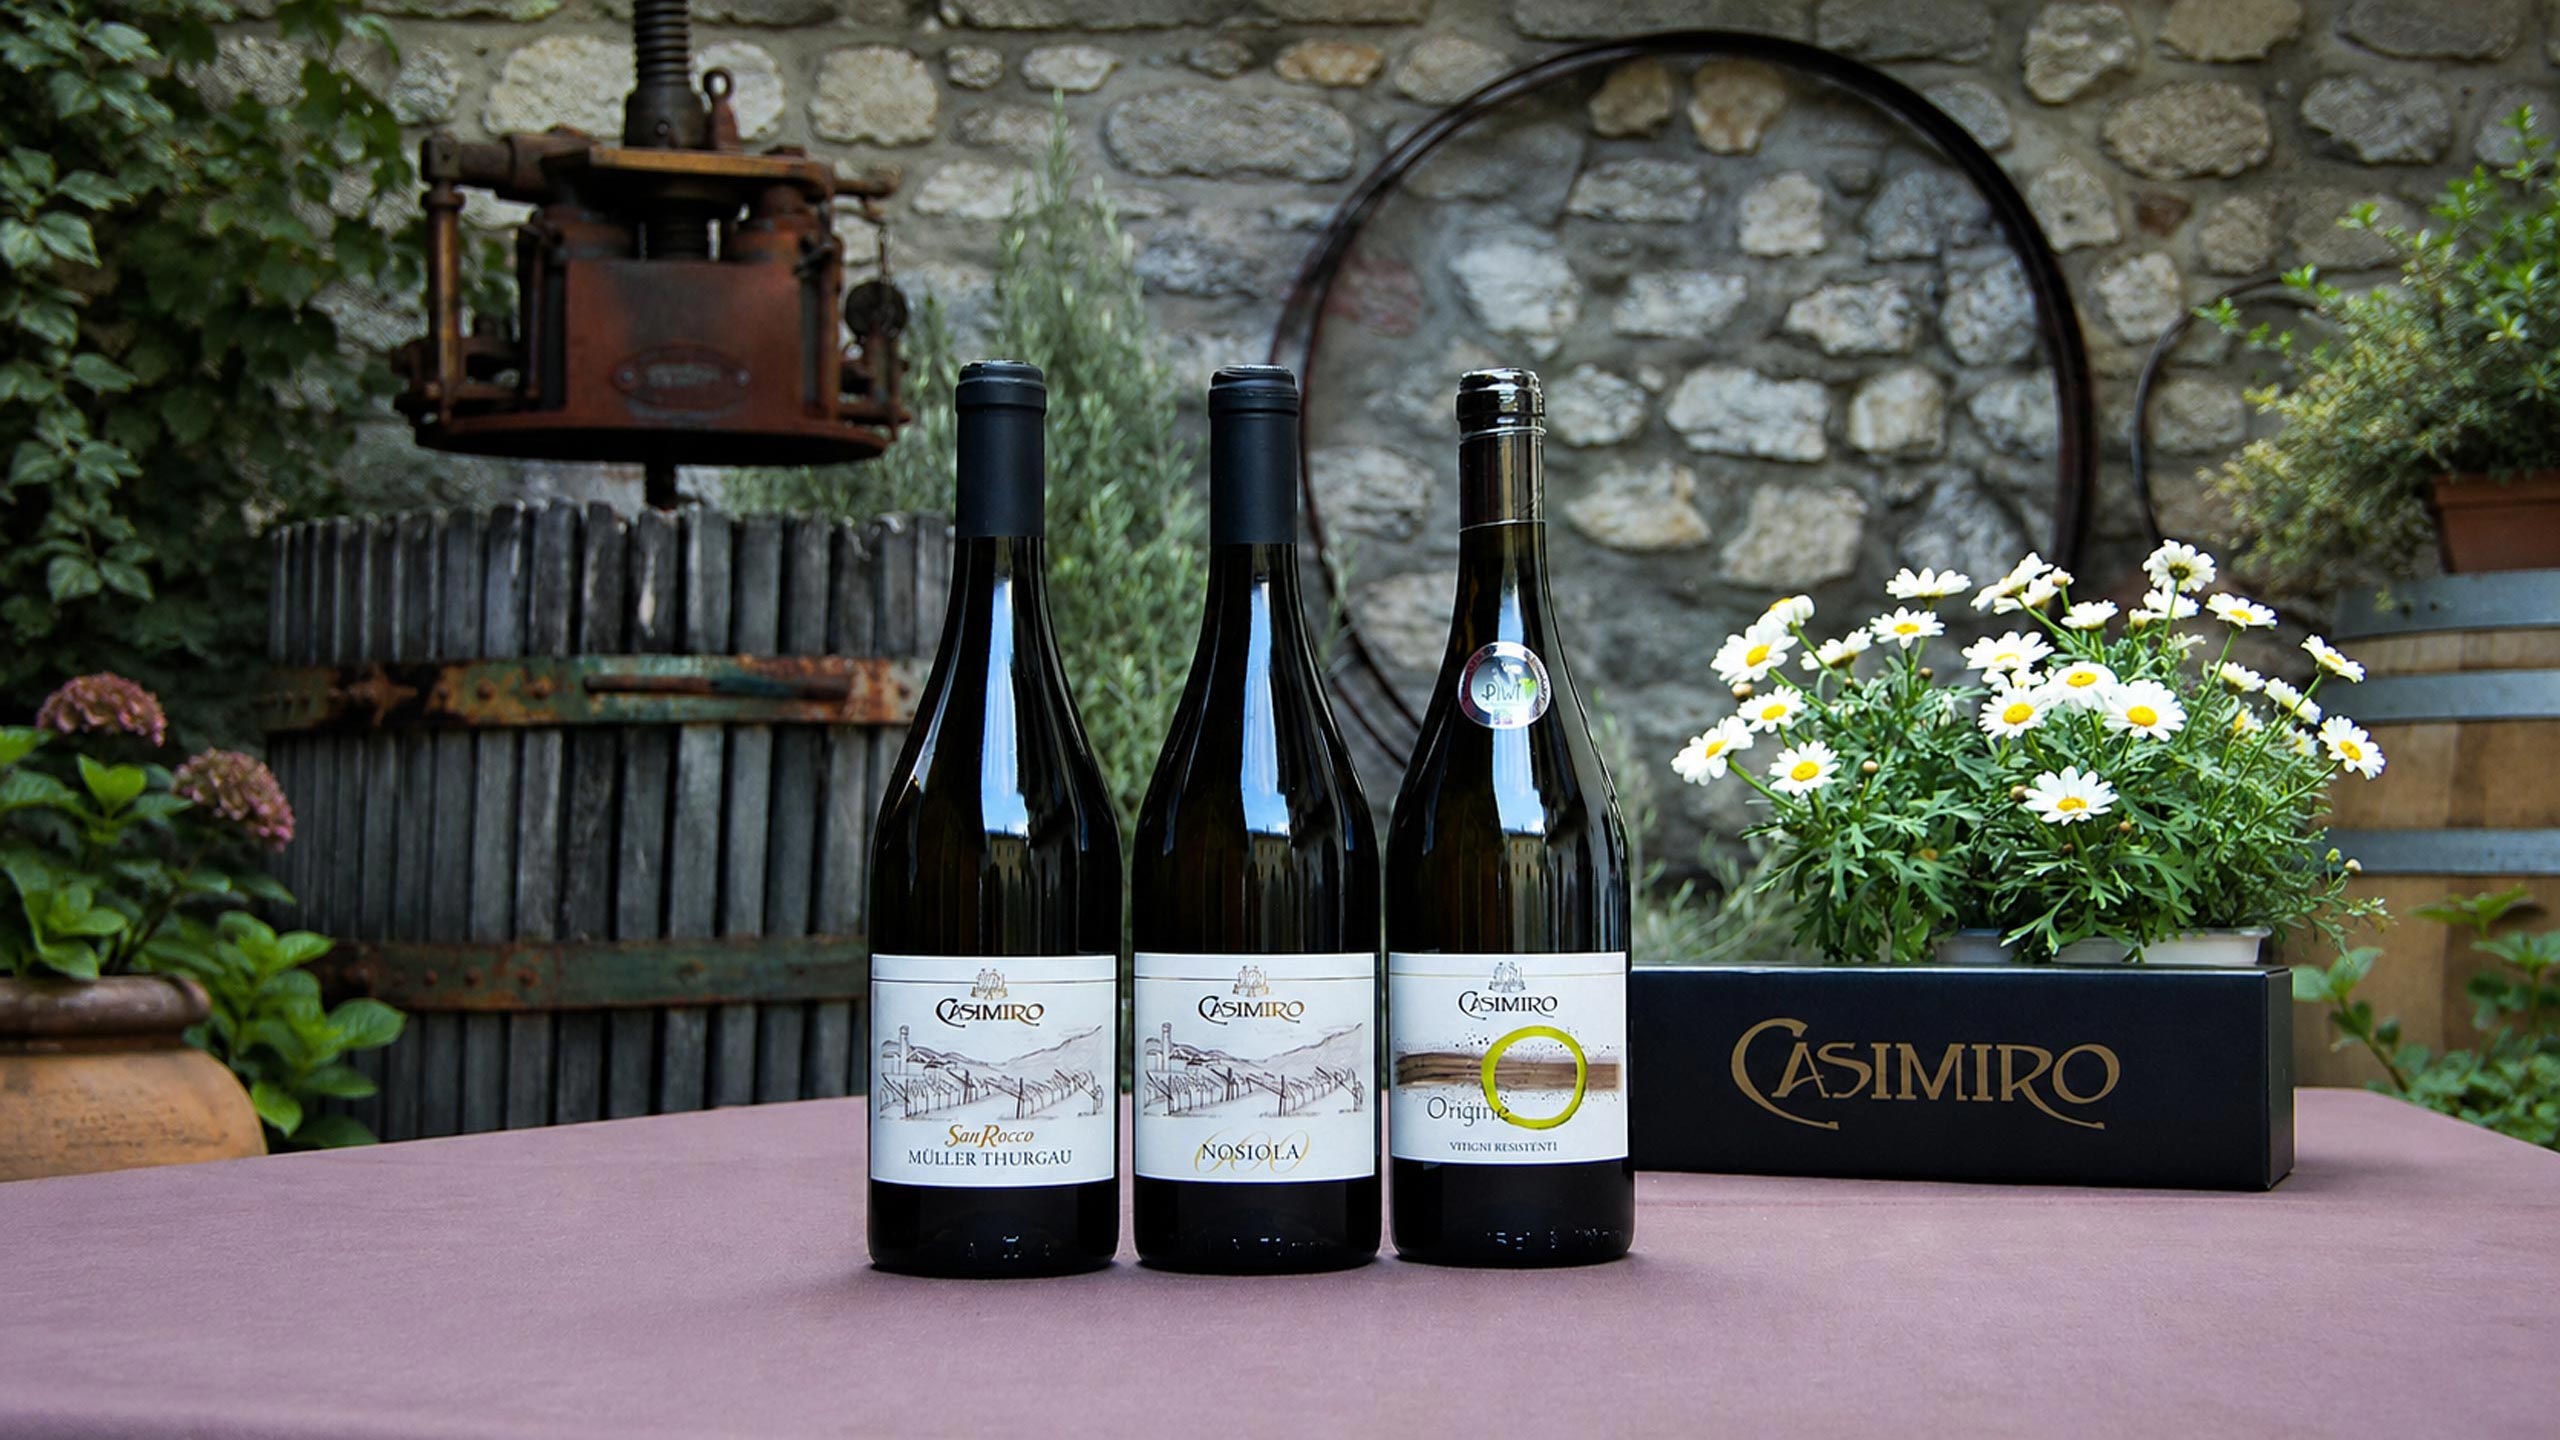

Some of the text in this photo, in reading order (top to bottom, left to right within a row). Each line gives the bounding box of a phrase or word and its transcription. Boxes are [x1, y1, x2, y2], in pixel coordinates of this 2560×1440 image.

[935, 998, 1044, 1028] CASIMIRO
[1198, 995, 1305, 1025] CASIMIRO
[1458, 991, 1558, 1020] CASIMIRO
[1731, 1018, 2121, 1130] CASIMIRO
[908, 1149, 1073, 1167] MÜLLER THURGAU
[1202, 1143, 1299, 1161] NOSIOLA
